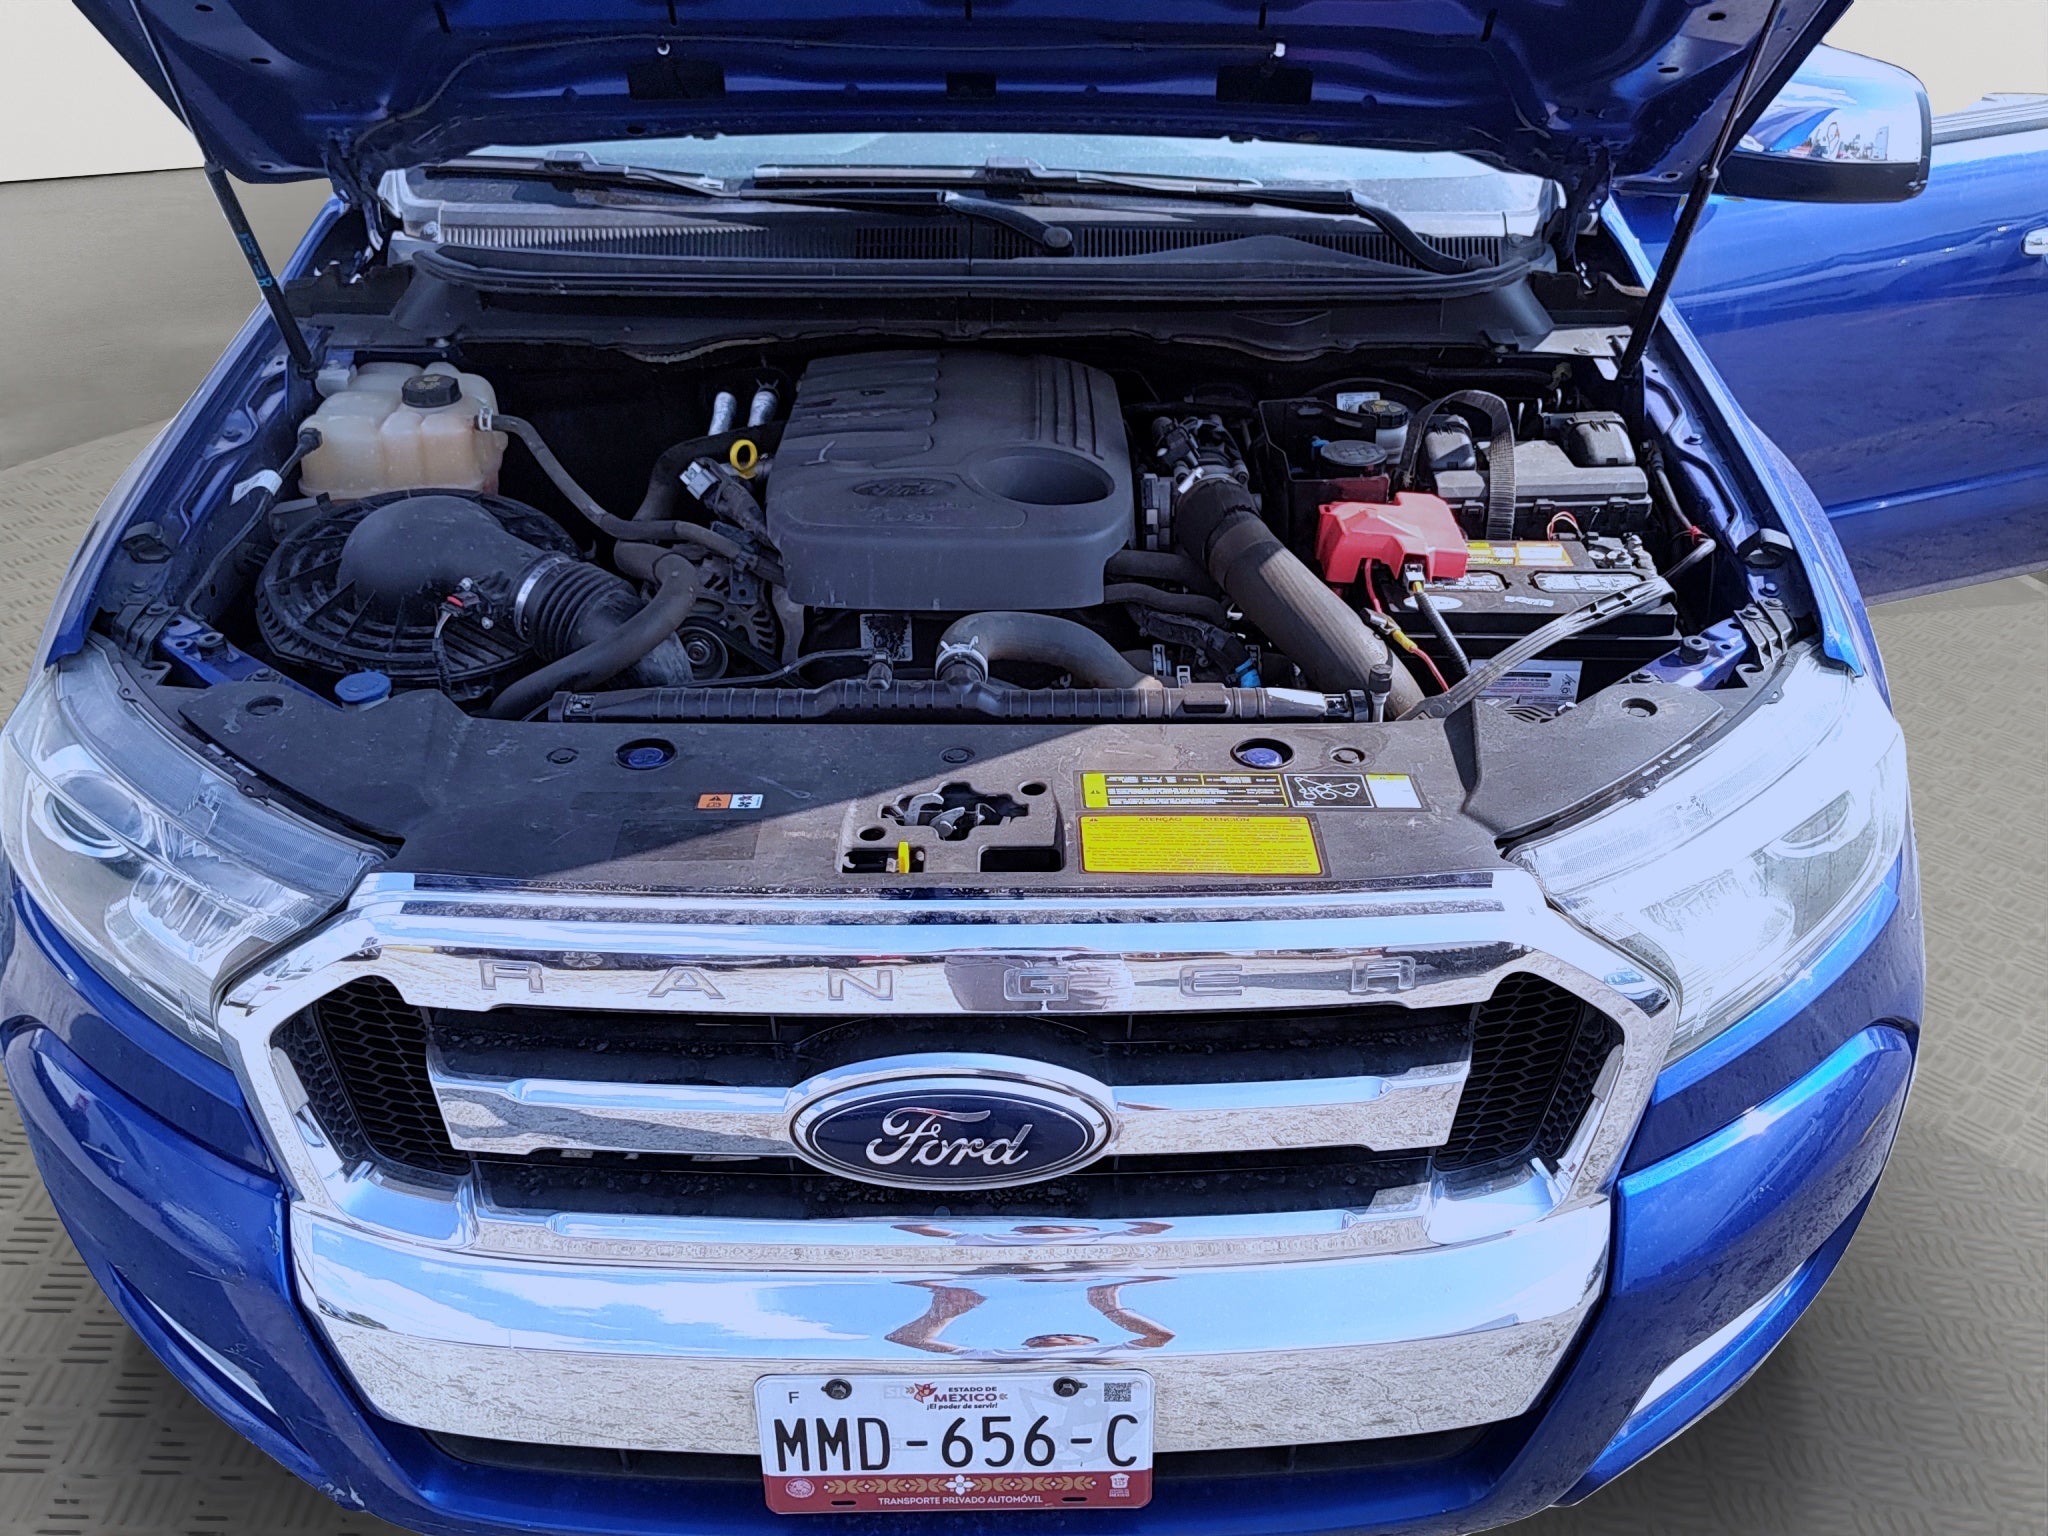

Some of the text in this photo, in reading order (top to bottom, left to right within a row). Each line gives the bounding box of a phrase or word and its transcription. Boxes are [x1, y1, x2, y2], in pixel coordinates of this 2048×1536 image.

[479, 955, 1416, 1001] RANGER
[865, 1107, 1033, 1165] Ford
[788, 1391, 799, 1403] F
[774, 1415, 1138, 1471] MMD-656-C
[878, 1494, 1043, 1505] TRANSPORTE PRIVADO AUTOMÓVIL
